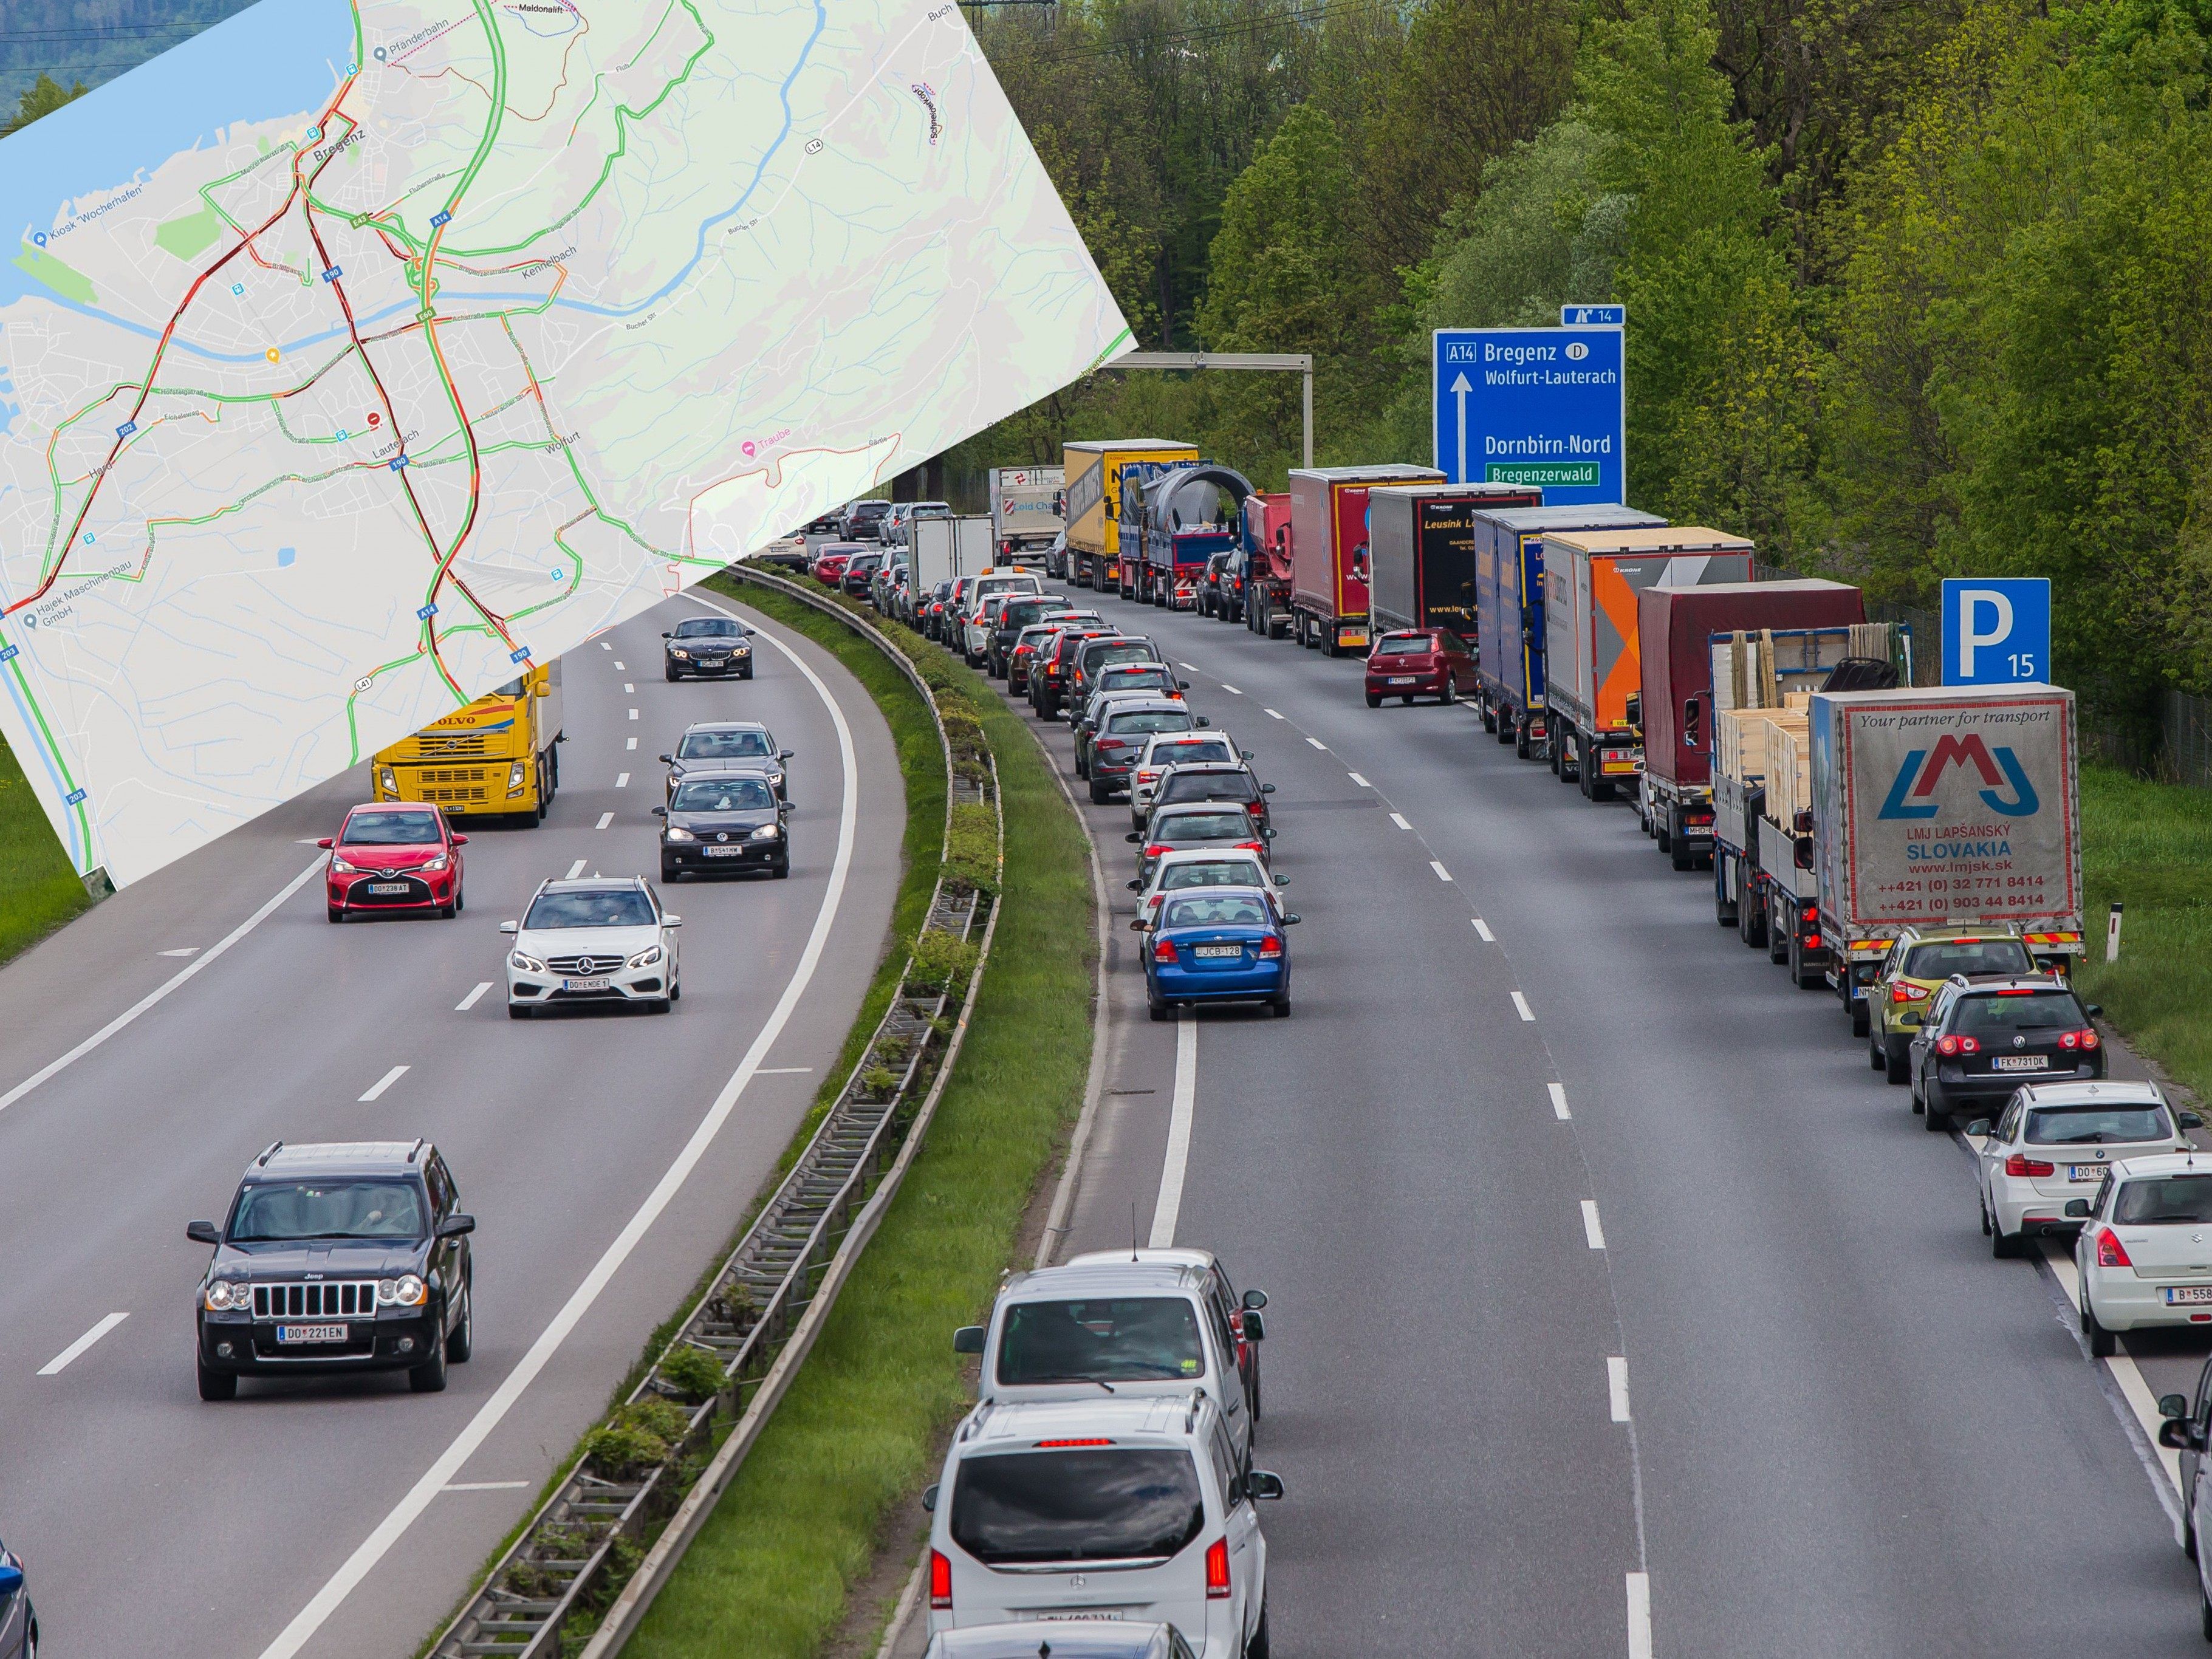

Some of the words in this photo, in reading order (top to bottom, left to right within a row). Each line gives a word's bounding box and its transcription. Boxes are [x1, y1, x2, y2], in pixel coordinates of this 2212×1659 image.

[1598, 310, 1612, 323] 14
[1450, 345, 1474, 360] A14
[1485, 343, 1556, 366] Bregenz
[1572, 345, 1582, 358] D
[1485, 369, 1616, 385] Wolfurt-Lauterach
[1485, 434, 1611, 455] Dornbirn-Nord
[1493, 467, 1592, 485] Bregenzerwald
[1013, 502, 1033, 511] Cold
[1425, 519, 1462, 529] Leusink
[1959, 589, 2014, 677] P
[2007, 654, 2035, 677] 15
[1860, 714, 1895, 728] Your
[1897, 713, 1955, 730] partner
[1955, 711, 1980, 728] for
[1984, 710, 2050, 725] transport
[1877, 733, 2040, 820] LMJ
[1907, 827, 1931, 840] LMJ
[1935, 821, 2012, 839] LAPŠANSKÝ
[1907, 841, 2012, 860] SLOVAKIA
[1908, 860, 2013, 875] www.lmjsk.sk
[1878, 881, 1922, 893] ++421
[1928, 880, 1948, 893] (0)
[1953, 879, 1971, 890] 32
[1976, 877, 2001, 889] 771
[2007, 875, 2044, 888] 8414
[1879, 899, 1923, 912] ++421
[1929, 898, 1949, 912] (0)
[1953, 897, 1981, 908] 903
[1985, 896, 2004, 907] 44
[2007, 894, 2045, 906] 8414
[1202, 946, 1240, 956] JCB-128
[2001, 1058, 2012, 1067] FK
[2078, 1168, 2090, 1177] DO
[2179, 1290, 2185, 1300] B
[288, 1328, 301, 1339] DO
